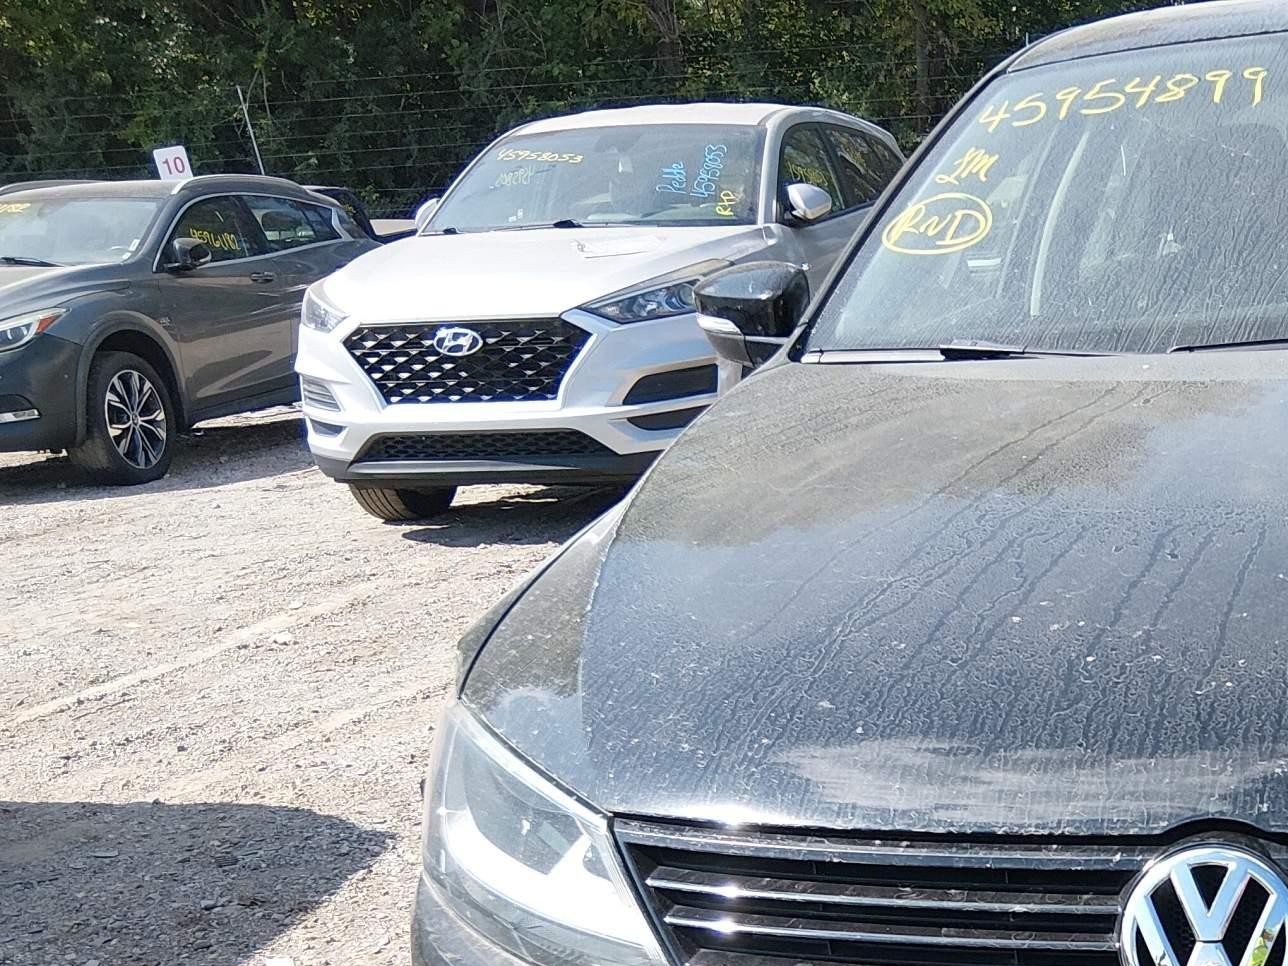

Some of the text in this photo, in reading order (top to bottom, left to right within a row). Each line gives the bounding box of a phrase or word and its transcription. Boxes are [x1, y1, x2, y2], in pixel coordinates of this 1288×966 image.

[978, 66, 1269, 133] 45954899
[162, 156, 186, 175] 10
[496, 148, 585, 164] 45958053
[887, 203, 987, 246] RND
